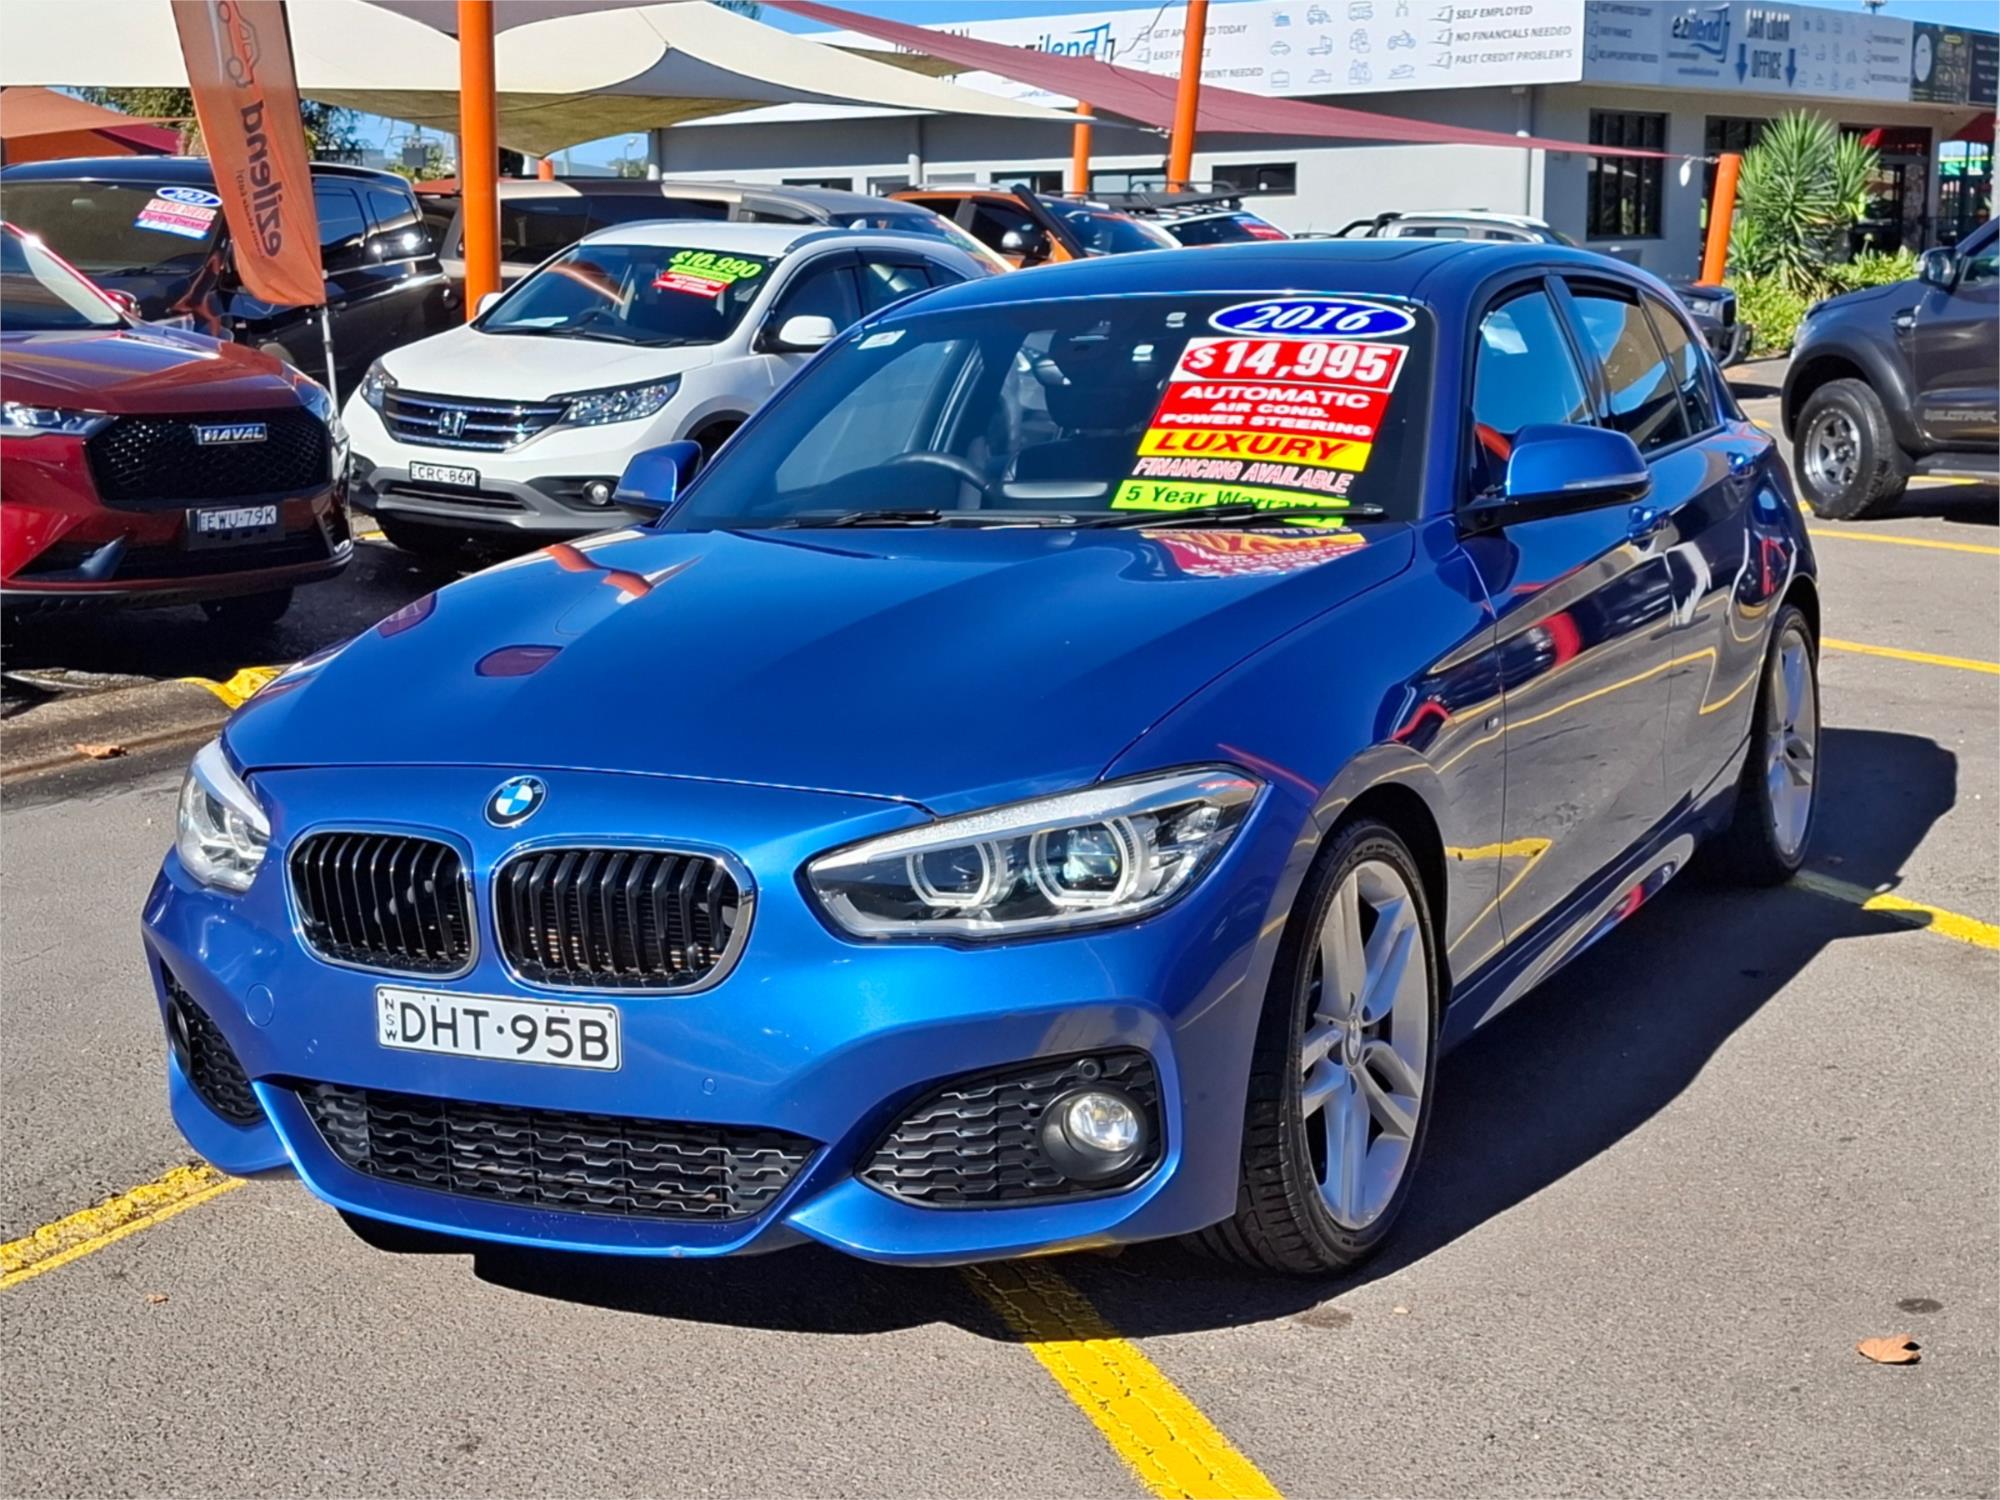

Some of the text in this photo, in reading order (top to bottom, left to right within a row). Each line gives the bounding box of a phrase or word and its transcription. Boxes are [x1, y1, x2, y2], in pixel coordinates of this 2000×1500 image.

[1456, 5, 1533, 20] SELF EMPLOYED
[1153, 29, 1170, 39] GET
[1218, 25, 1248, 36] TODAY
[1455, 26, 1572, 41] NO FINANCIALS NEEDED
[1153, 50, 1175, 60] EASY
[1455, 49, 1573, 64] PAST CREDIT PROBLEM'S
[1230, 67, 1264, 77] NEEDED
[1234, 306, 1385, 331] 2016
[1180, 386, 1371, 409] AUTOMATIC
[1211, 402, 1329, 418] AIR COND.
[1160, 413, 1373, 437] POWER STEERING
[204, 427, 264, 441] HAVAL
[1154, 432, 1352, 462] LUXURY
[1131, 457, 1355, 494] FINANCING AVAILABLE
[1125, 486, 1143, 502] 5
[1152, 487, 1207, 505] Year
